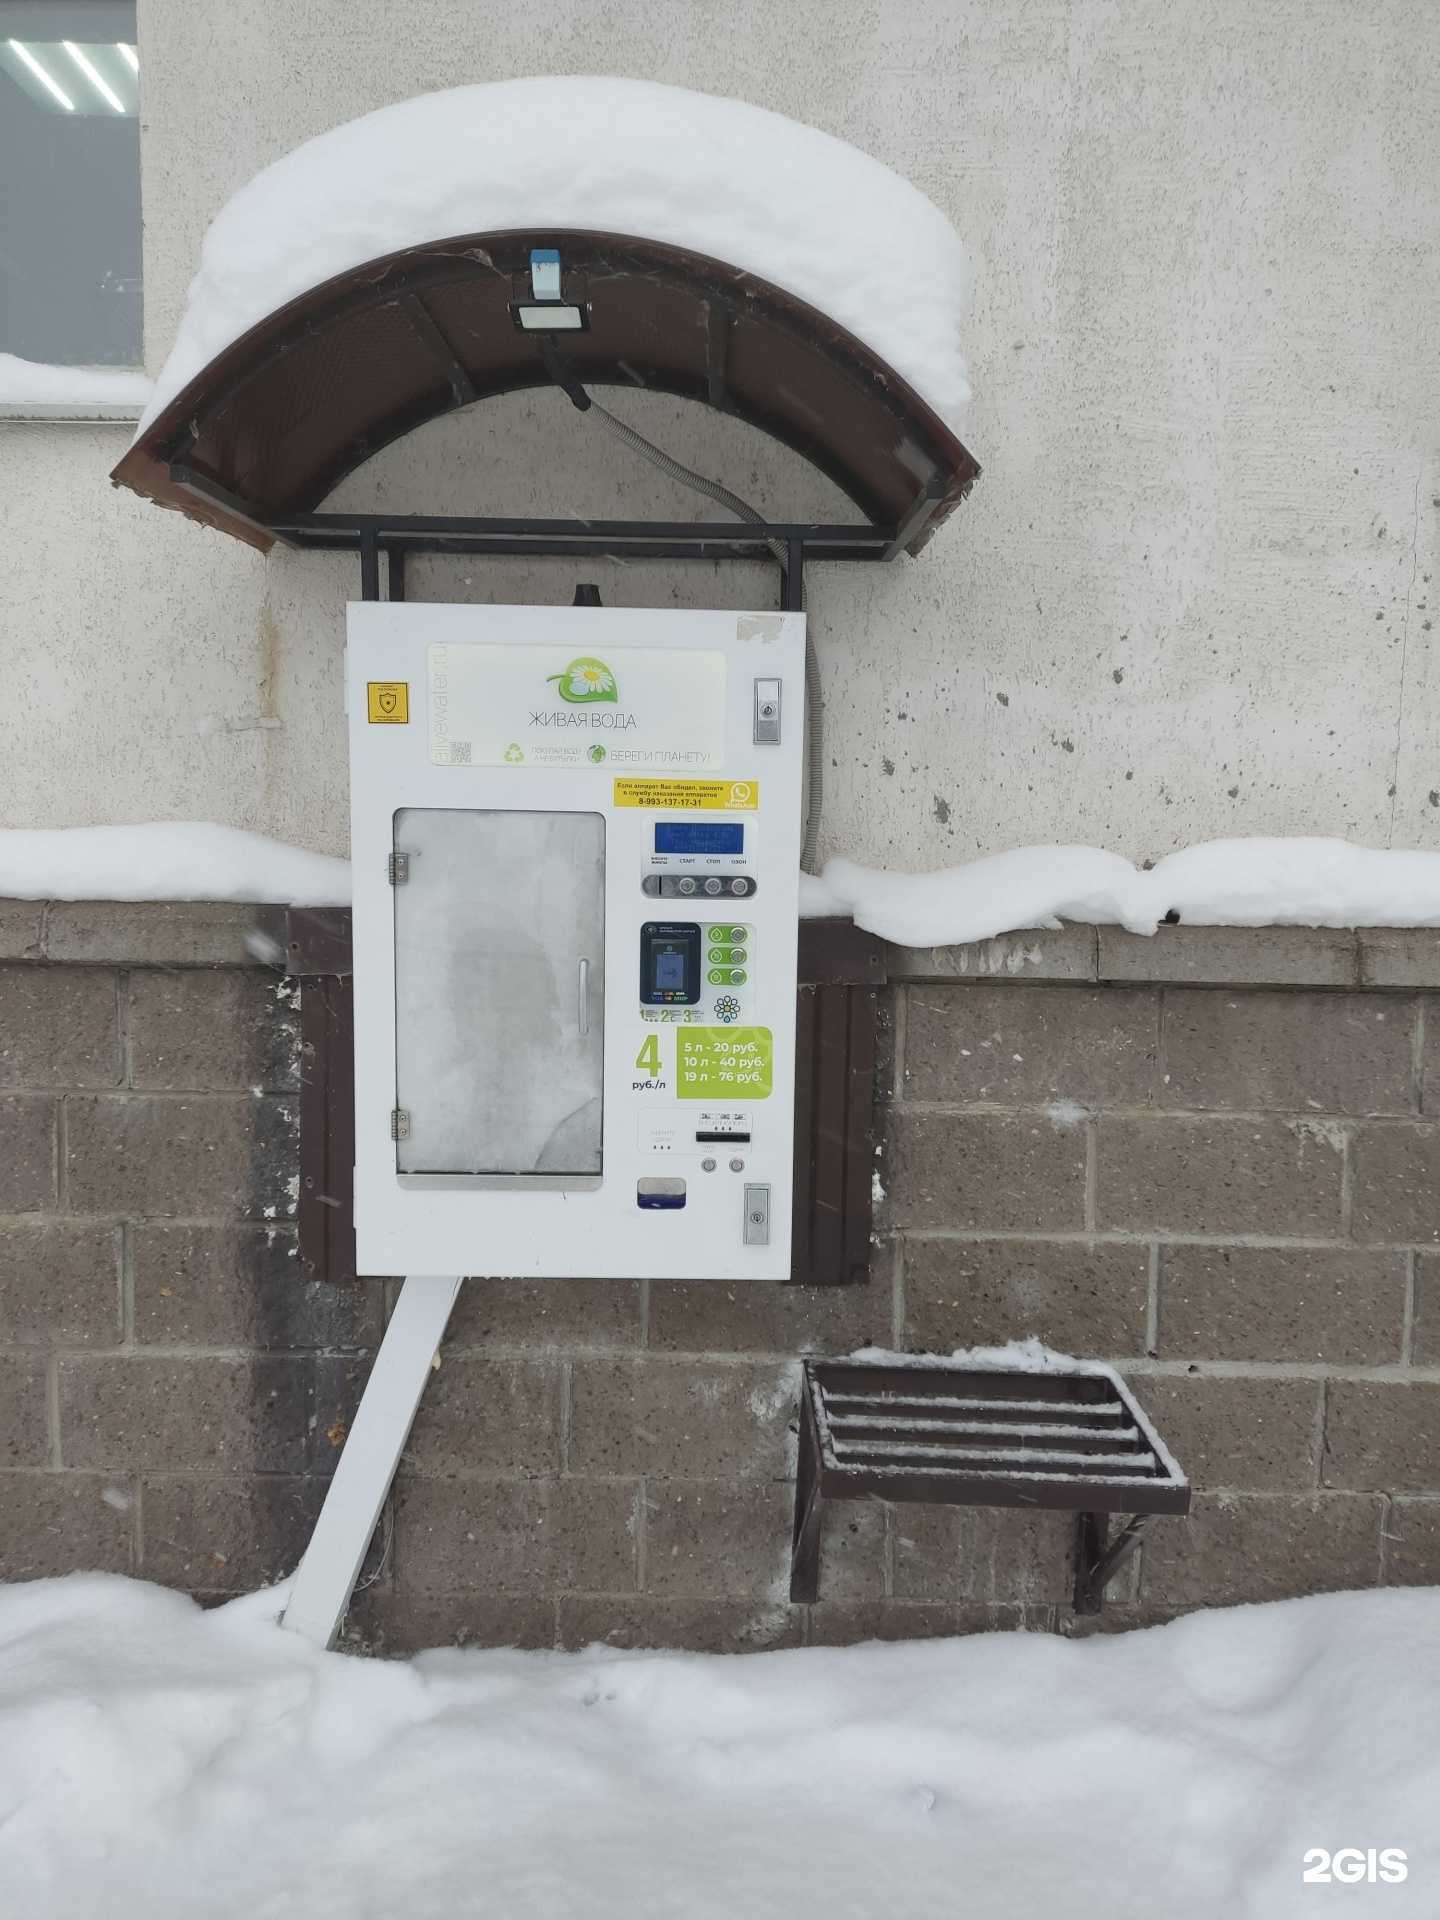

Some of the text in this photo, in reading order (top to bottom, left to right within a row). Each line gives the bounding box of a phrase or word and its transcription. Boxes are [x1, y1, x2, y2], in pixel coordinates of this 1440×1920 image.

[528, 711, 638, 730] ЖИВАЯ ВОДА
[610, 750, 711, 763] БЕРЕГИ ПЛАНЕТУ!
[638, 797, 702, 806] 8-993-137-17-31
[661, 1009, 669, 1023] 2
[683, 1009, 692, 1023] 3
[684, 1042, 692, 1052] 5
[694, 1044, 703, 1052] л
[713, 1042, 729, 1052] 20
[732, 1041, 759, 1054] руб.
[636, 1034, 662, 1078] 4
[685, 1057, 697, 1067] 10
[700, 1058, 709, 1067] л
[719, 1057, 736, 1067] 40
[739, 1056, 766, 1069] руб.
[685, 1071, 697, 1082] 19
[699, 1073, 708, 1082] л
[719, 1071, 734, 1082] 76
[736, 1071, 763, 1084] руб.
[632, 1079, 666, 1091] руб./л
